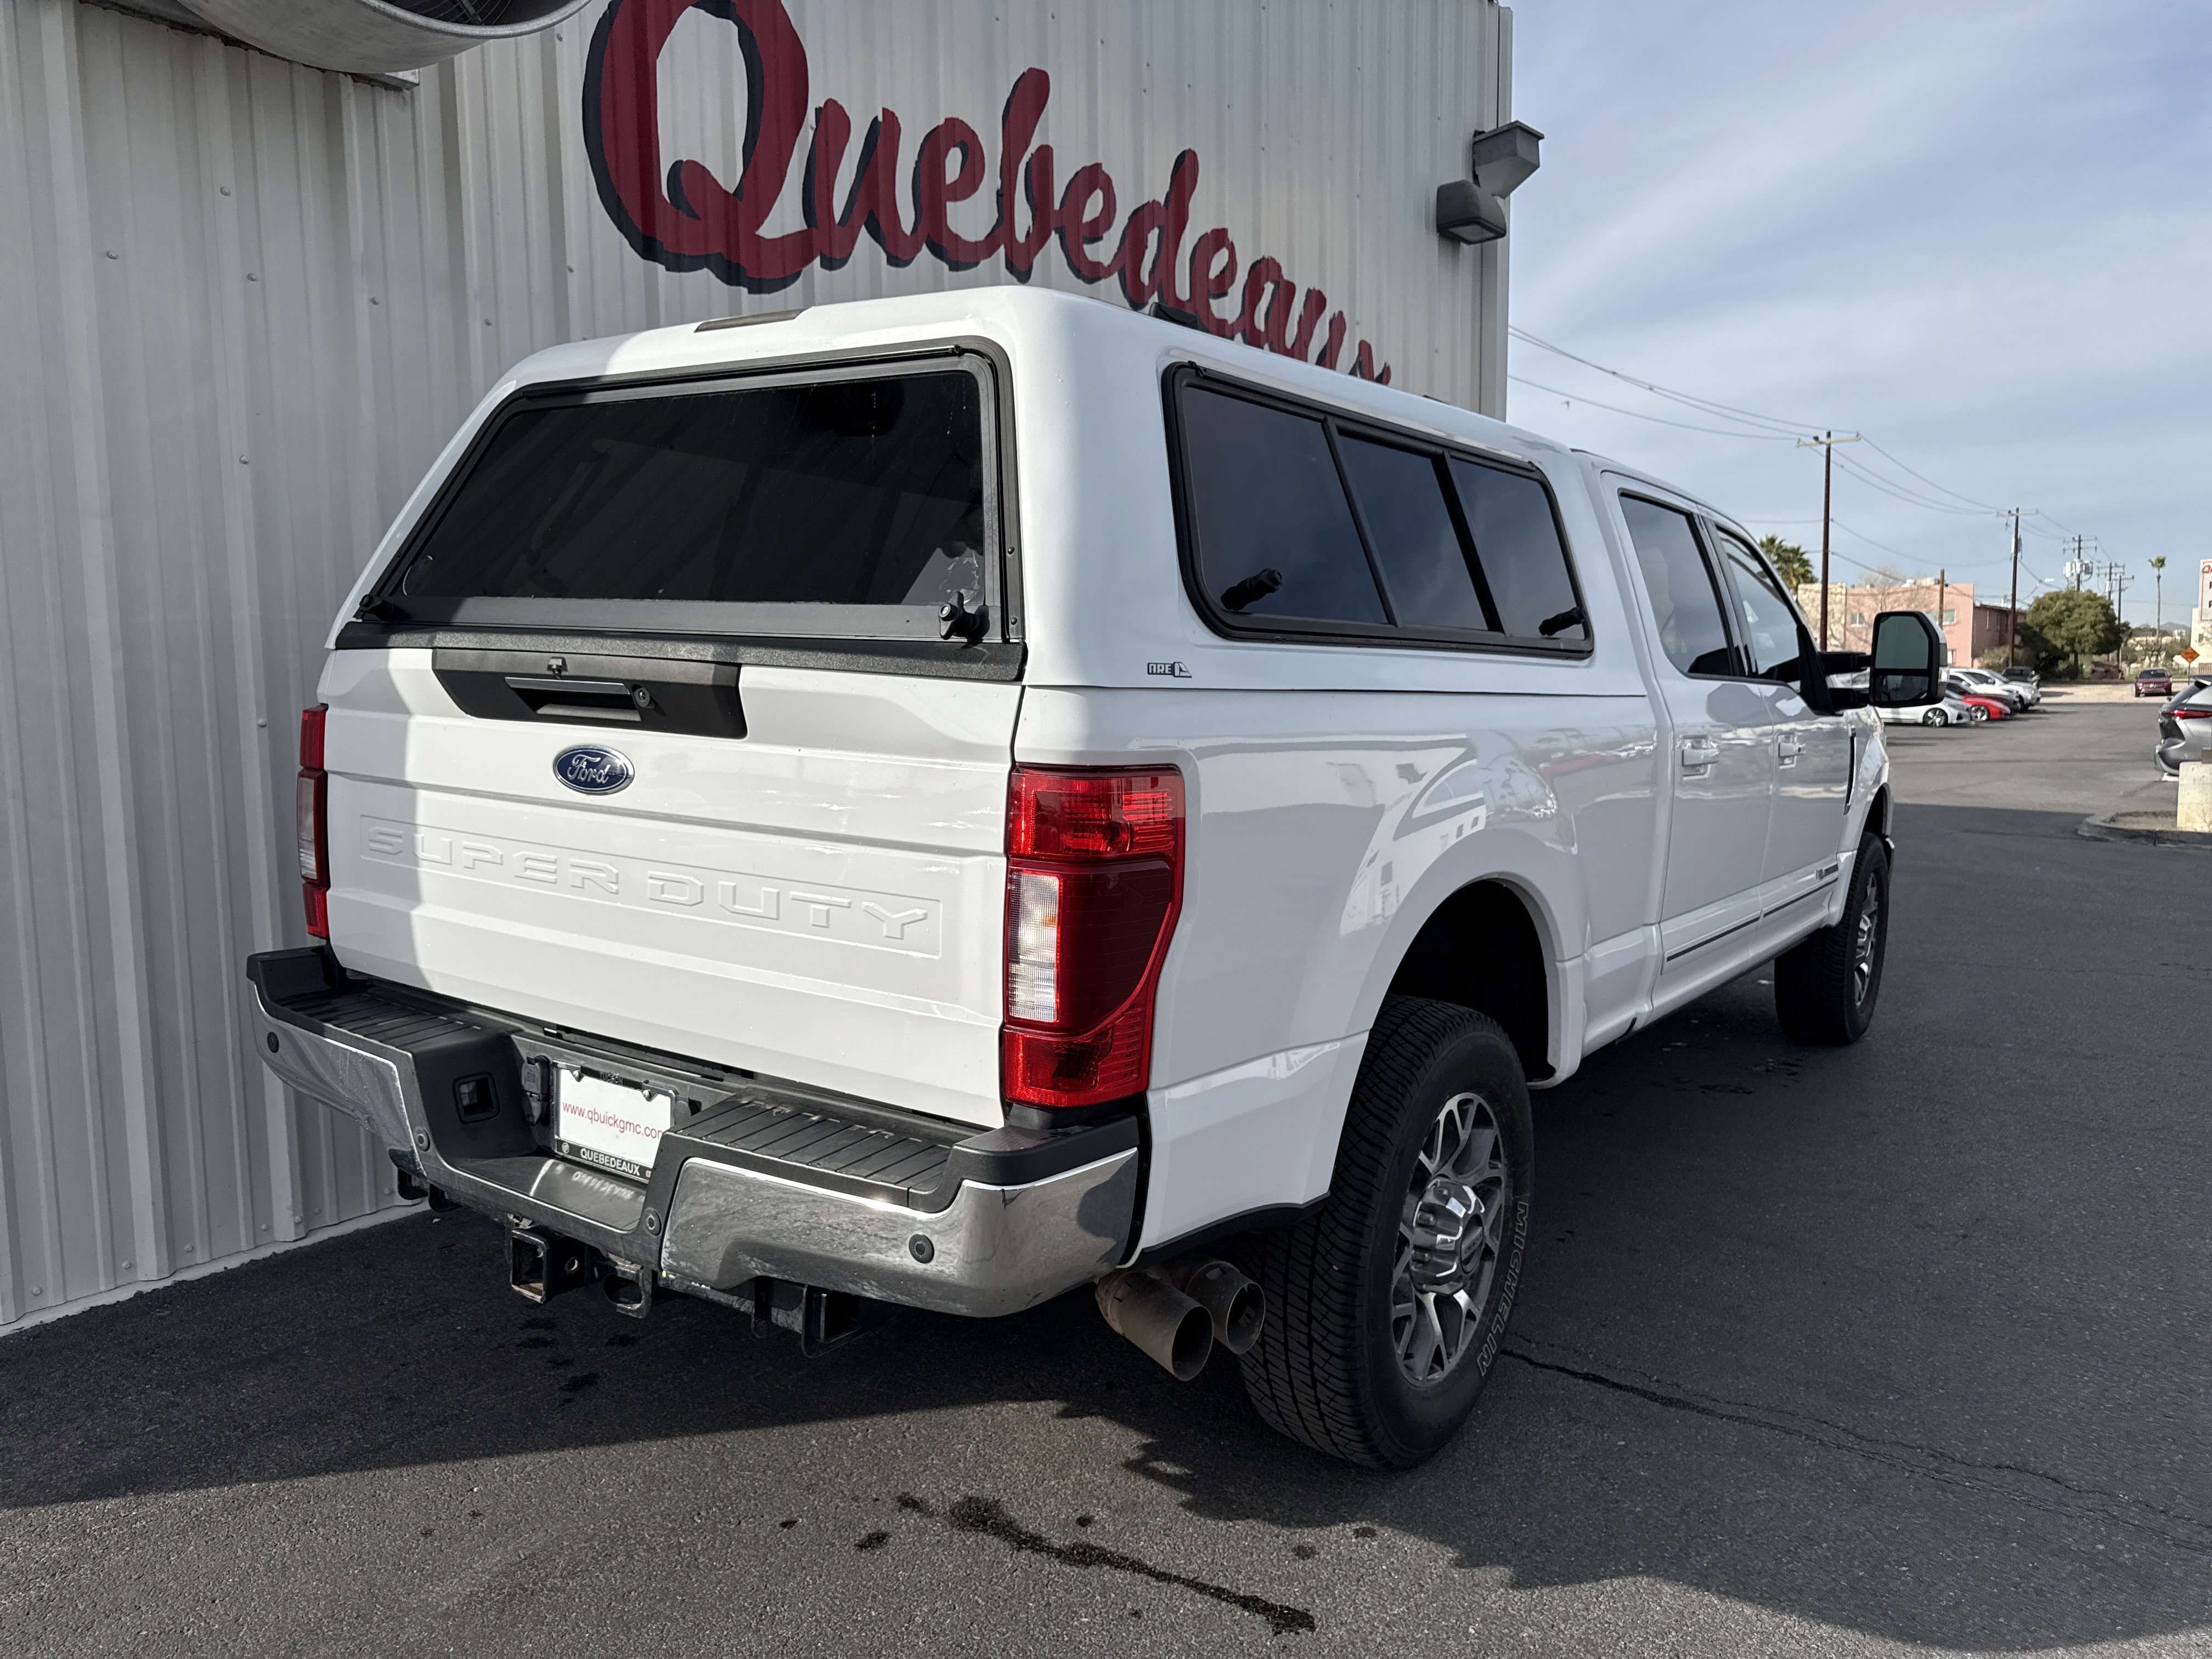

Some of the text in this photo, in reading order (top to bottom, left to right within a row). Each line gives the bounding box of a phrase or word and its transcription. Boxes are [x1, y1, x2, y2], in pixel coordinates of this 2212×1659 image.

[567, 754, 611, 784] Ford
[368, 826, 928, 940] SUPER DUTY
[580, 1148, 640, 1176] QUEBEDEAUX
[1476, 1201, 1529, 1376] MICHELIN
